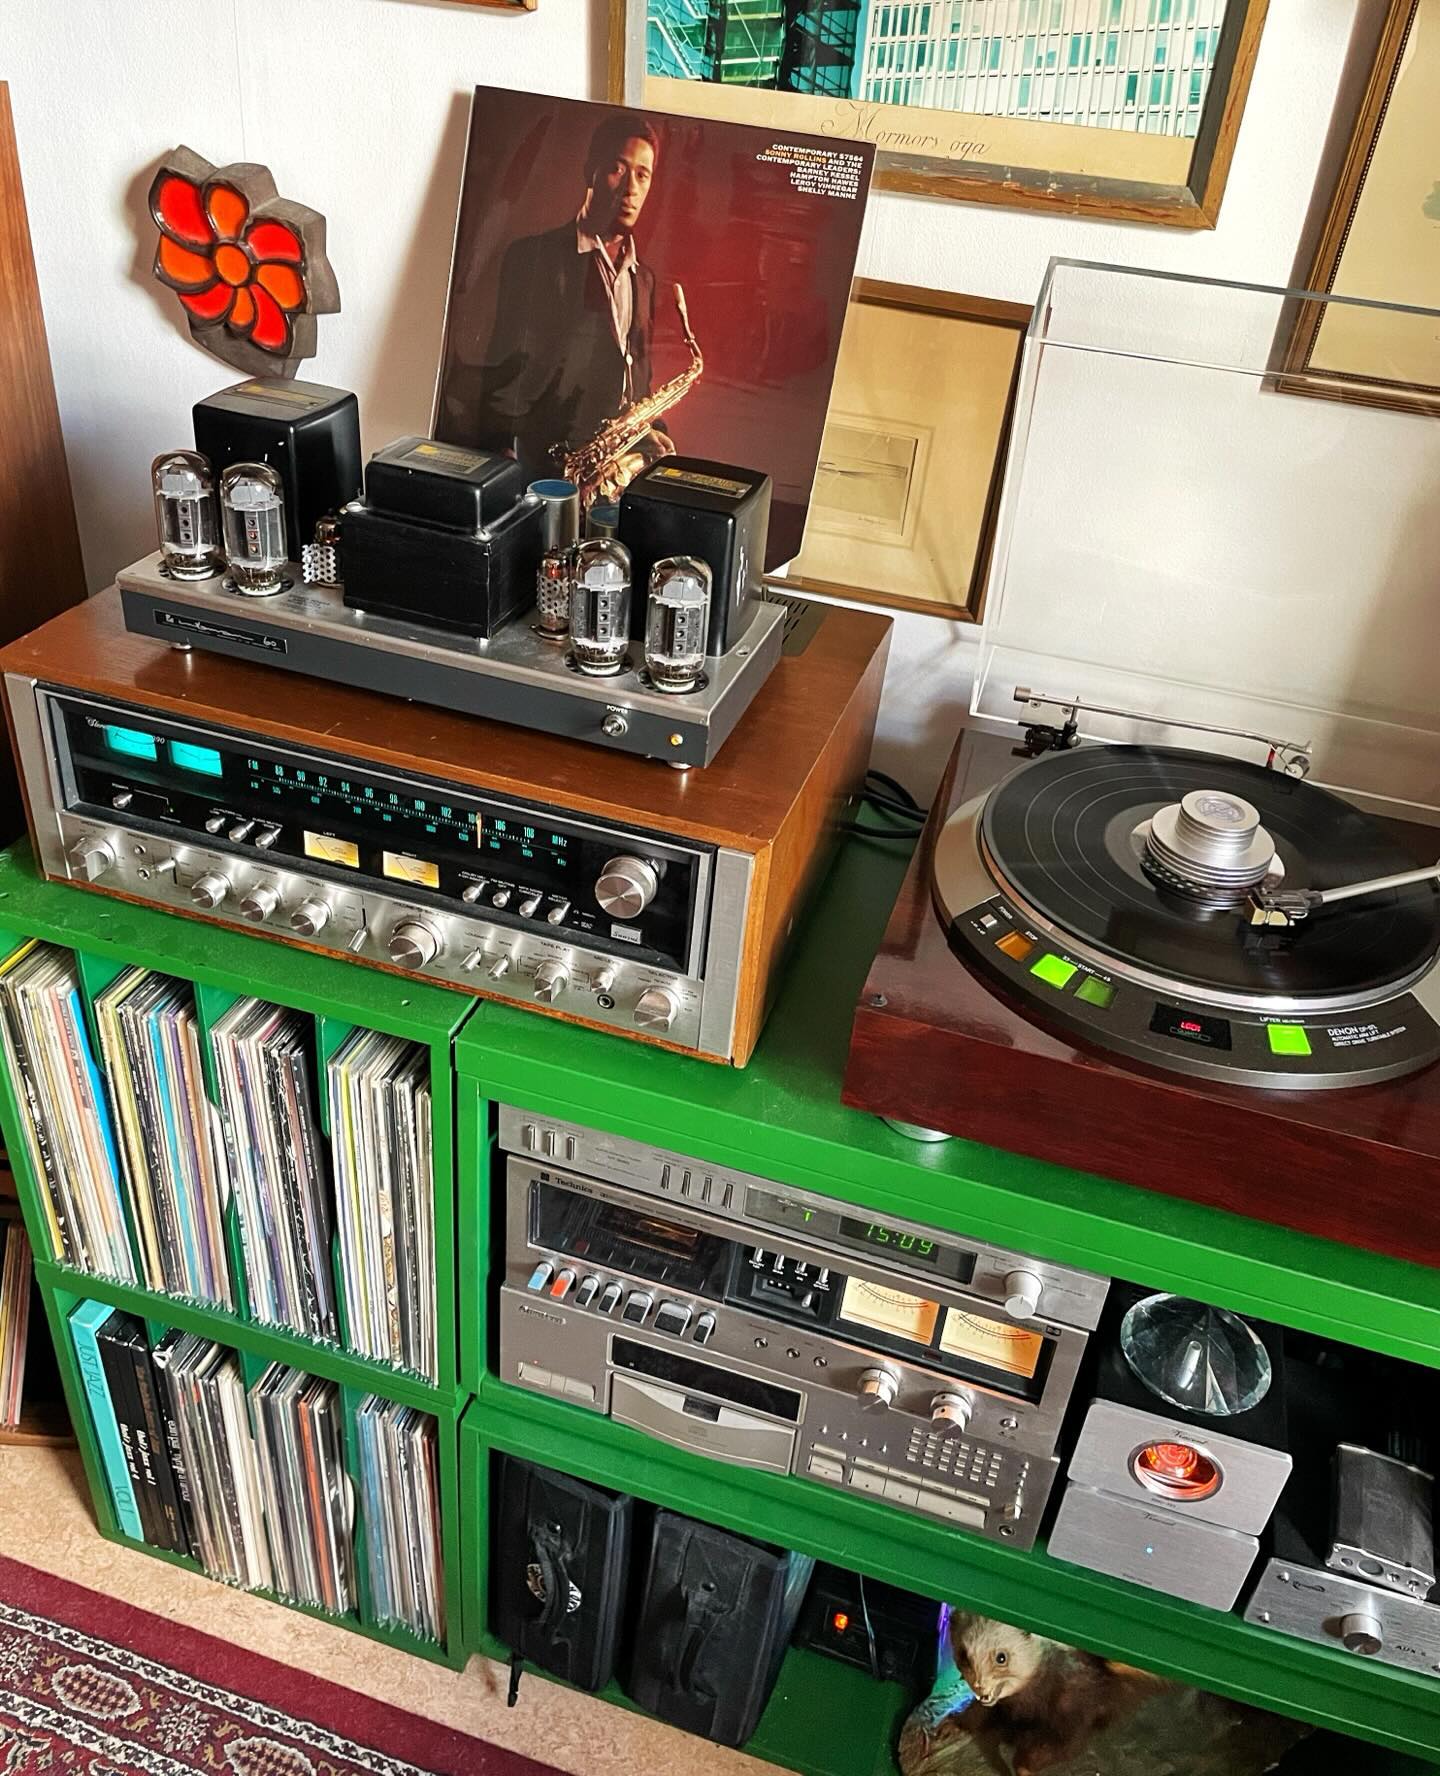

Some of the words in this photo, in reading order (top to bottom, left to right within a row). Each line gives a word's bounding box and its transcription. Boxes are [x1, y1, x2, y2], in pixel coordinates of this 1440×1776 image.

[820, 102, 938, 148] Mormors
[765, 149, 792, 158] SONNY
[794, 154, 827, 164] ROLLINS
[772, 144, 838, 158] CONTEMPORARY
[756, 154, 821, 168] CONTEMPORARY
[790, 172, 829, 182] HAMPTON
[832, 178, 858, 187] HAWES
[797, 167, 828, 176] BARNEY
[830, 172, 860, 181] KESSEL
[790, 179, 816, 188] LEROY
[818, 182, 858, 192] VINNEGAR
[798, 186, 825, 194] SHELLY
[828, 190, 856, 200] MANNE
[606, 704, 628, 714] POWER
[296, 770, 306, 782] 90
[318, 776, 328, 788] 92
[341, 782, 350, 792] 94
[364, 787, 374, 798] 96
[389, 793, 398, 804] 98
[414, 800, 426, 812] 100
[441, 806, 452, 818] 102
[552, 834, 568, 848] MHz
[1327, 1026, 1358, 1036] DENON
[554, 1176, 593, 1194] Technics
[866, 1223, 934, 1254] 15:09
